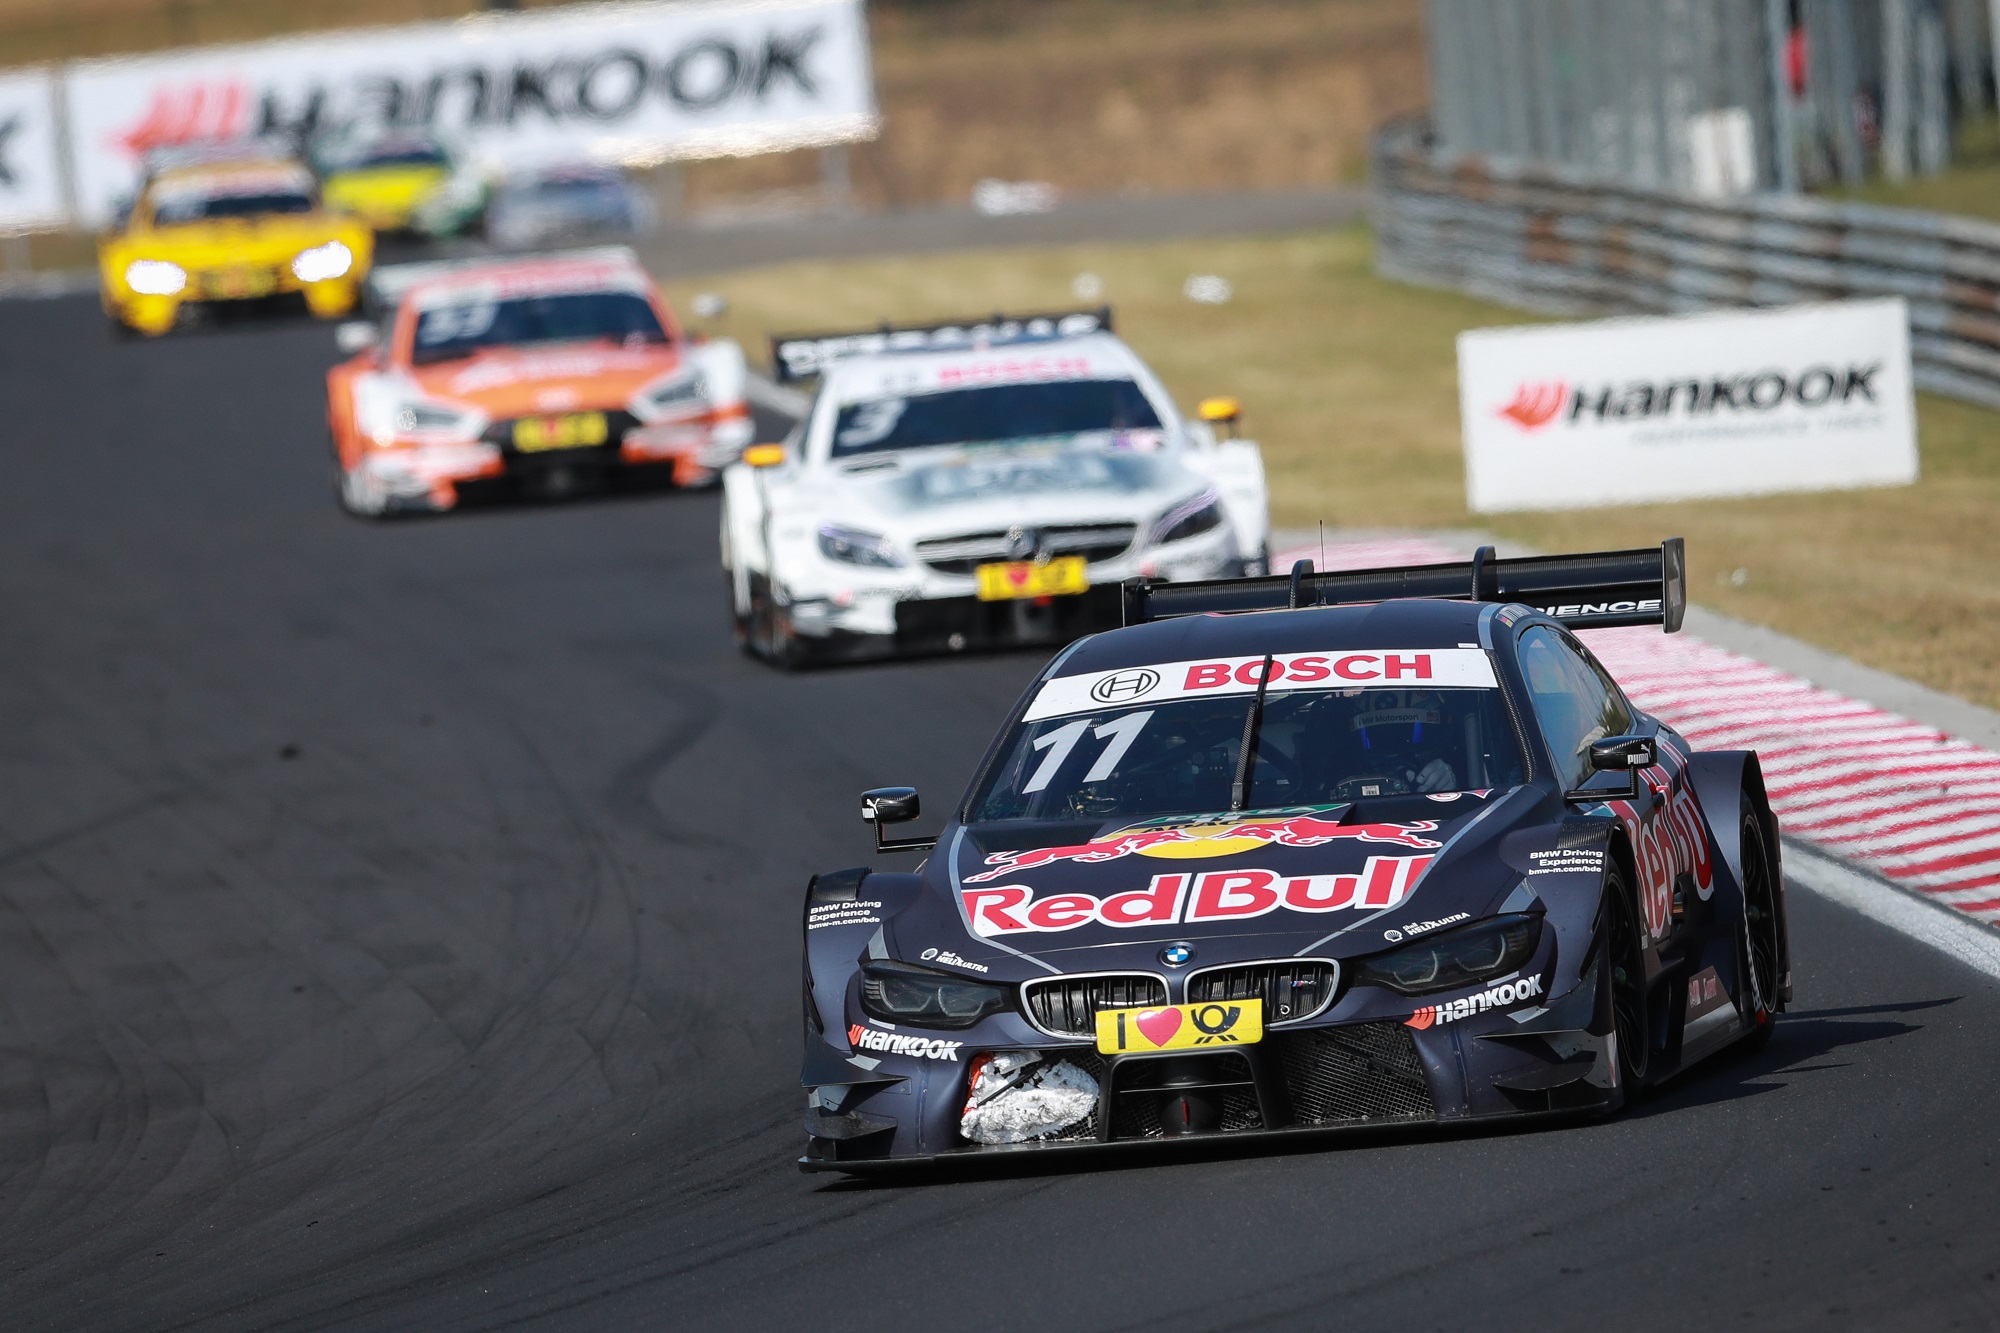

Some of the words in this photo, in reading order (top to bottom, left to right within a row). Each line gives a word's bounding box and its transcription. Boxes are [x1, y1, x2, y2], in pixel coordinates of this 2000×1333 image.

[1182, 654, 1433, 691] BOSCH
[1022, 709, 1156, 795] 11
[1627, 752, 1650, 765] PUMA
[1529, 850, 1561, 859] BMW
[1562, 849, 1604, 858] Driving
[1539, 857, 1603, 867] Experience
[1528, 865, 1602, 876] bmw-m.com/bde
[961, 873, 1192, 938] Red
[1184, 854, 1438, 923] Bull
[810, 904, 841, 914] BMW
[841, 900, 882, 909] Driving
[808, 916, 881, 930] bmw-m.com/bde
[809, 909, 871, 923] Experience
[1406, 920, 1440, 936] HELIX
[1438, 912, 1471, 926] ULTRA
[962, 961, 989, 974] ULTRA
[1117, 1012, 1127, 1050] I
